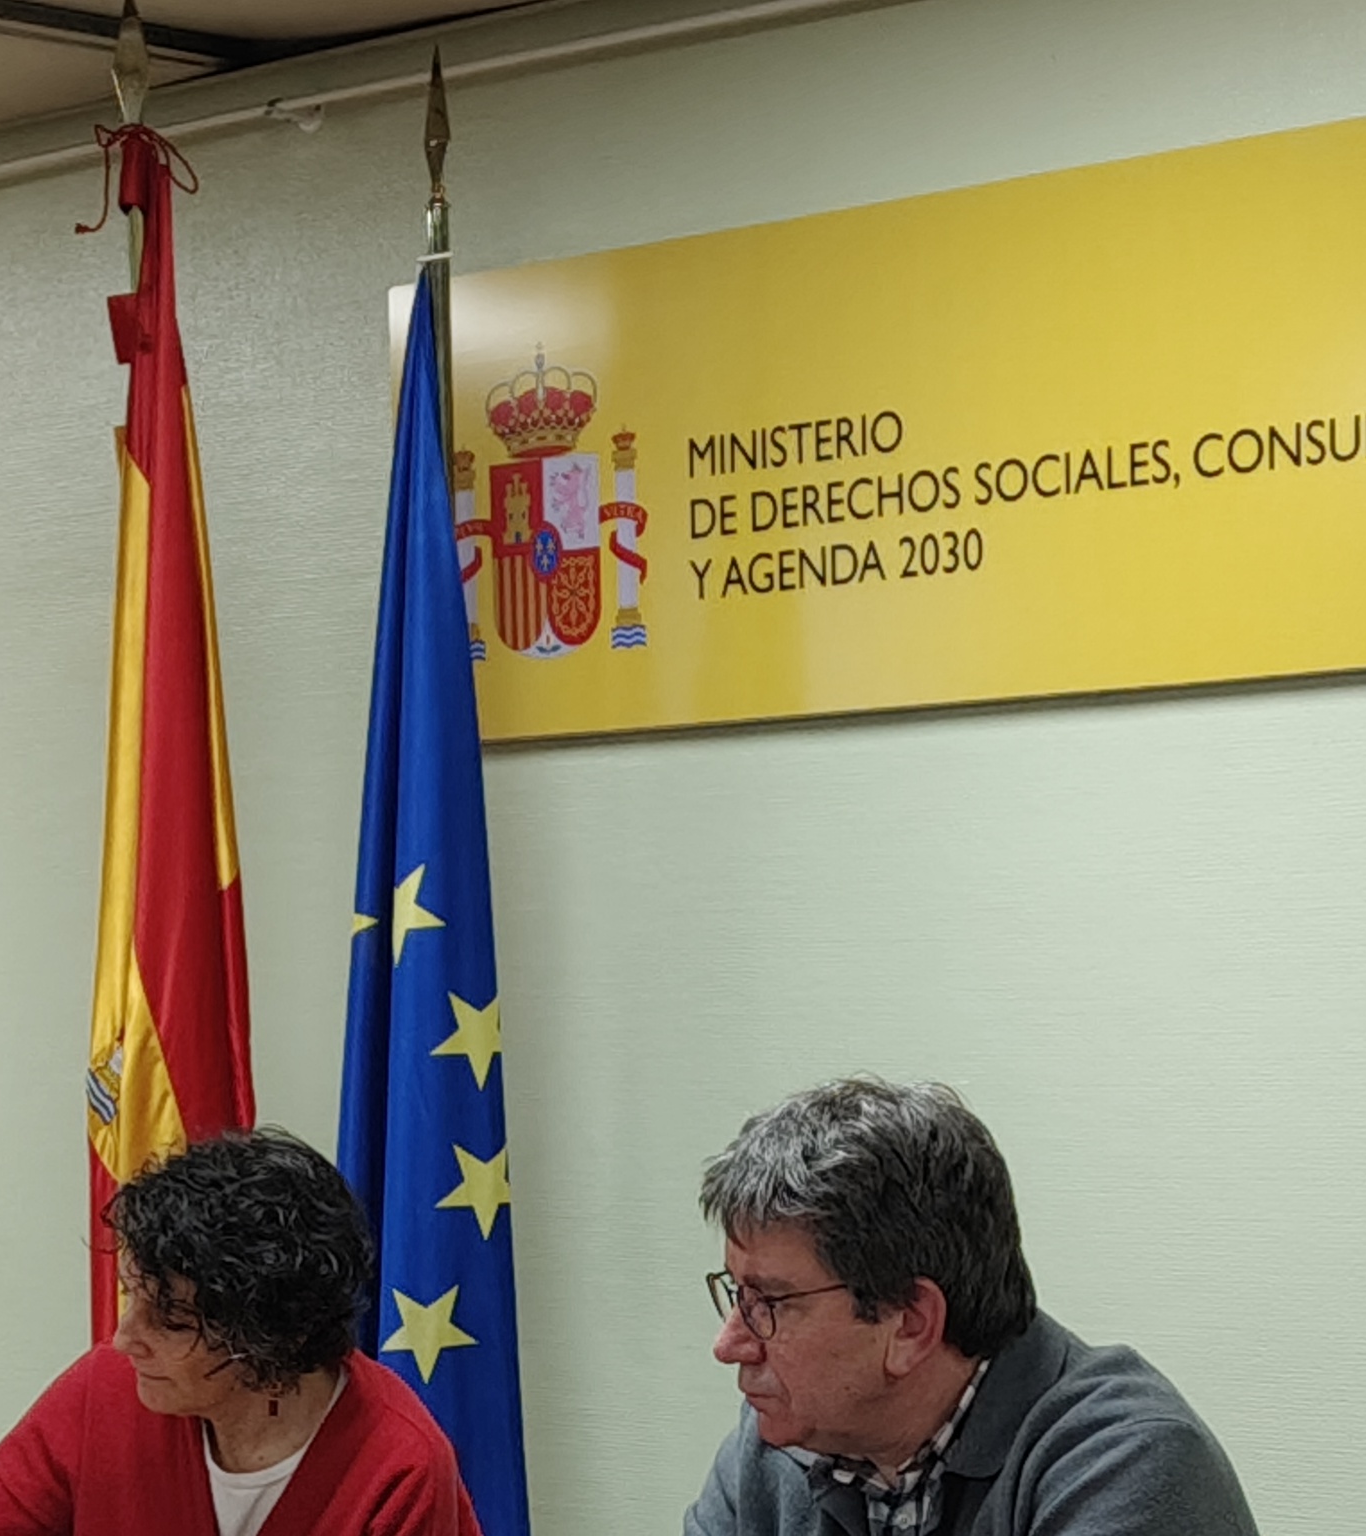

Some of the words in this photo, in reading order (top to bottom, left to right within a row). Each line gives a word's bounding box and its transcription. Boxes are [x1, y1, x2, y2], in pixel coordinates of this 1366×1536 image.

[688, 410, 903, 479] MINISTERIO
[689, 494, 738, 540] DE
[750, 466, 962, 533] DERECHOS
[974, 439, 1181, 506] SOCIALES,
[689, 558, 713, 600] Y
[720, 540, 887, 599] AGENDA
[898, 527, 984, 579] 2030
